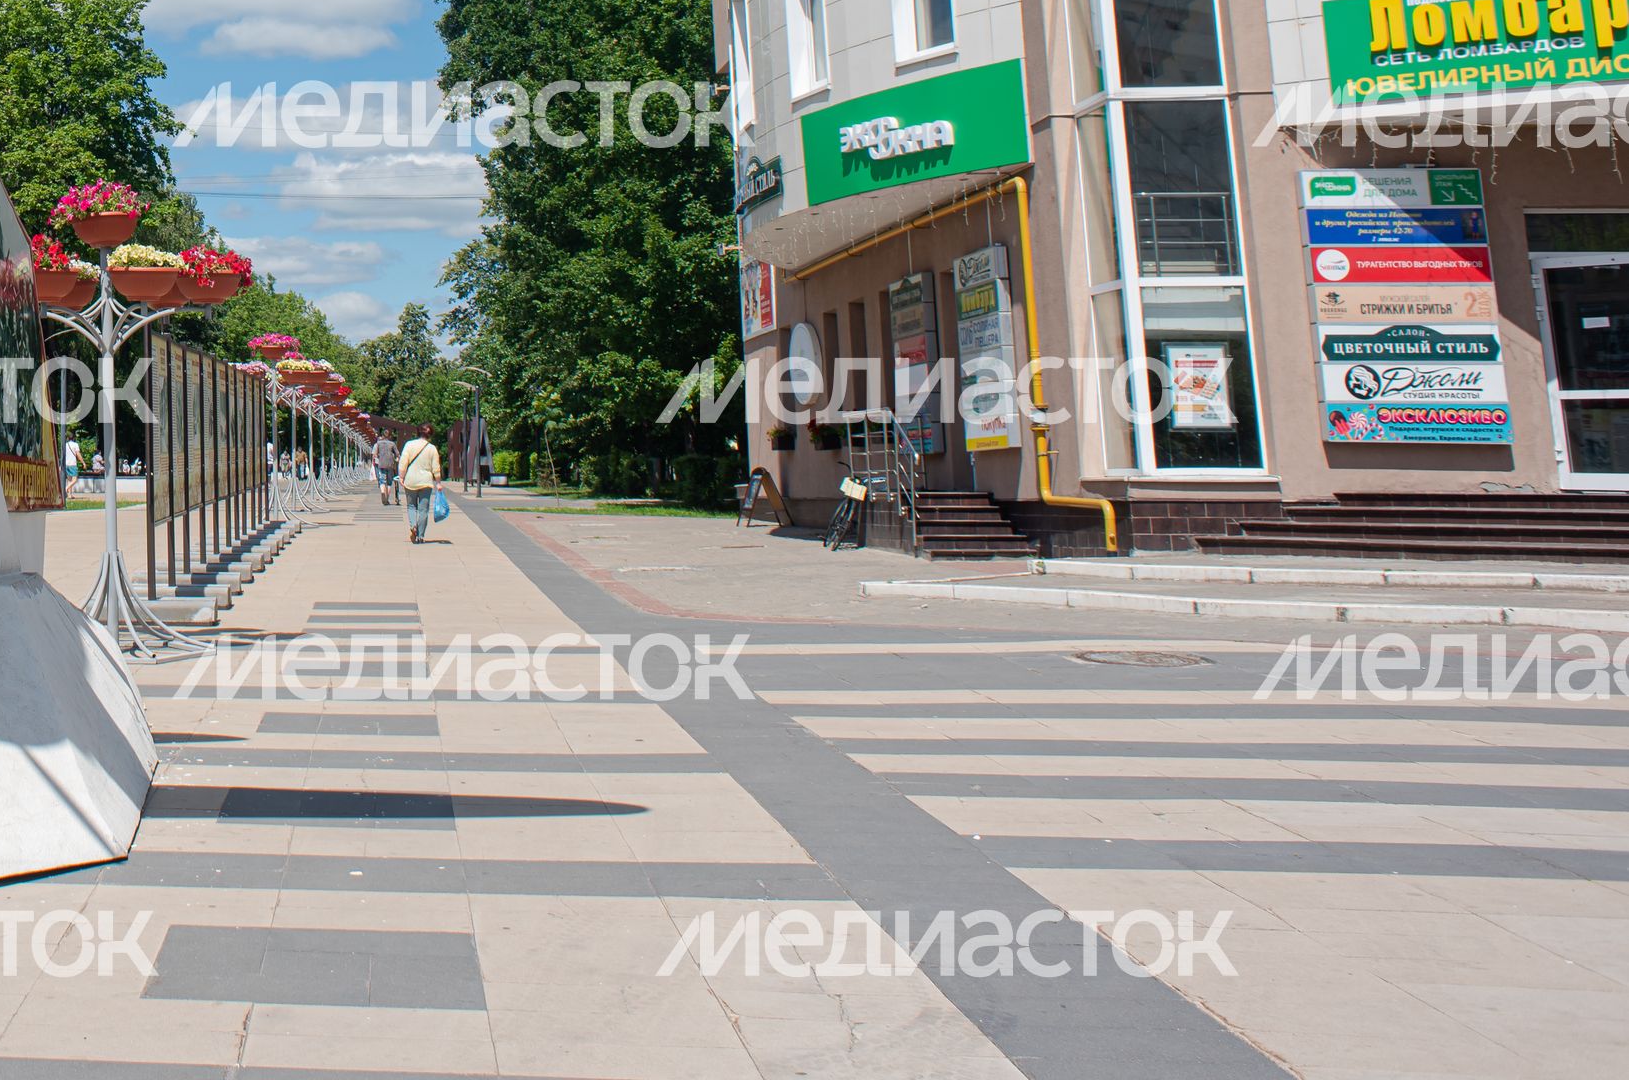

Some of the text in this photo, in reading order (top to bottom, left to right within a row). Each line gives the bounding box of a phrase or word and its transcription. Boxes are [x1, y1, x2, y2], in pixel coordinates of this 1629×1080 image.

[1374, 36, 1587, 68] СЕТЬ ЛОМБАРДОВ
[1346, 57, 1557, 98] ЮВЕЛИРНЫЙ
[1362, 177, 1412, 186] РЕШЕНИЯ
[1363, 188, 1418, 198] ДЛЯ ДОМА
[1356, 260, 1413, 269] ТУРАГЕНТСТВО
[1413, 260, 1457, 269] ВЫГОДНЫХ
[1360, 303, 1406, 315] СТРИЖКИ
[1407, 304, 1414, 314] И
[1416, 303, 1454, 315] БРИТЬЯ
[1464, 292, 1478, 318] 2
[1391, 328, 1426, 337] САЛОН
[1333, 339, 1489, 356] ЦВЕТОЧНЫЙ СТИЛЬ
[1403, 391, 1481, 399] СТУДИЯ КРАСОТЫ
[1376, 407, 1508, 426] ЭКСКЛЮЗИВО
